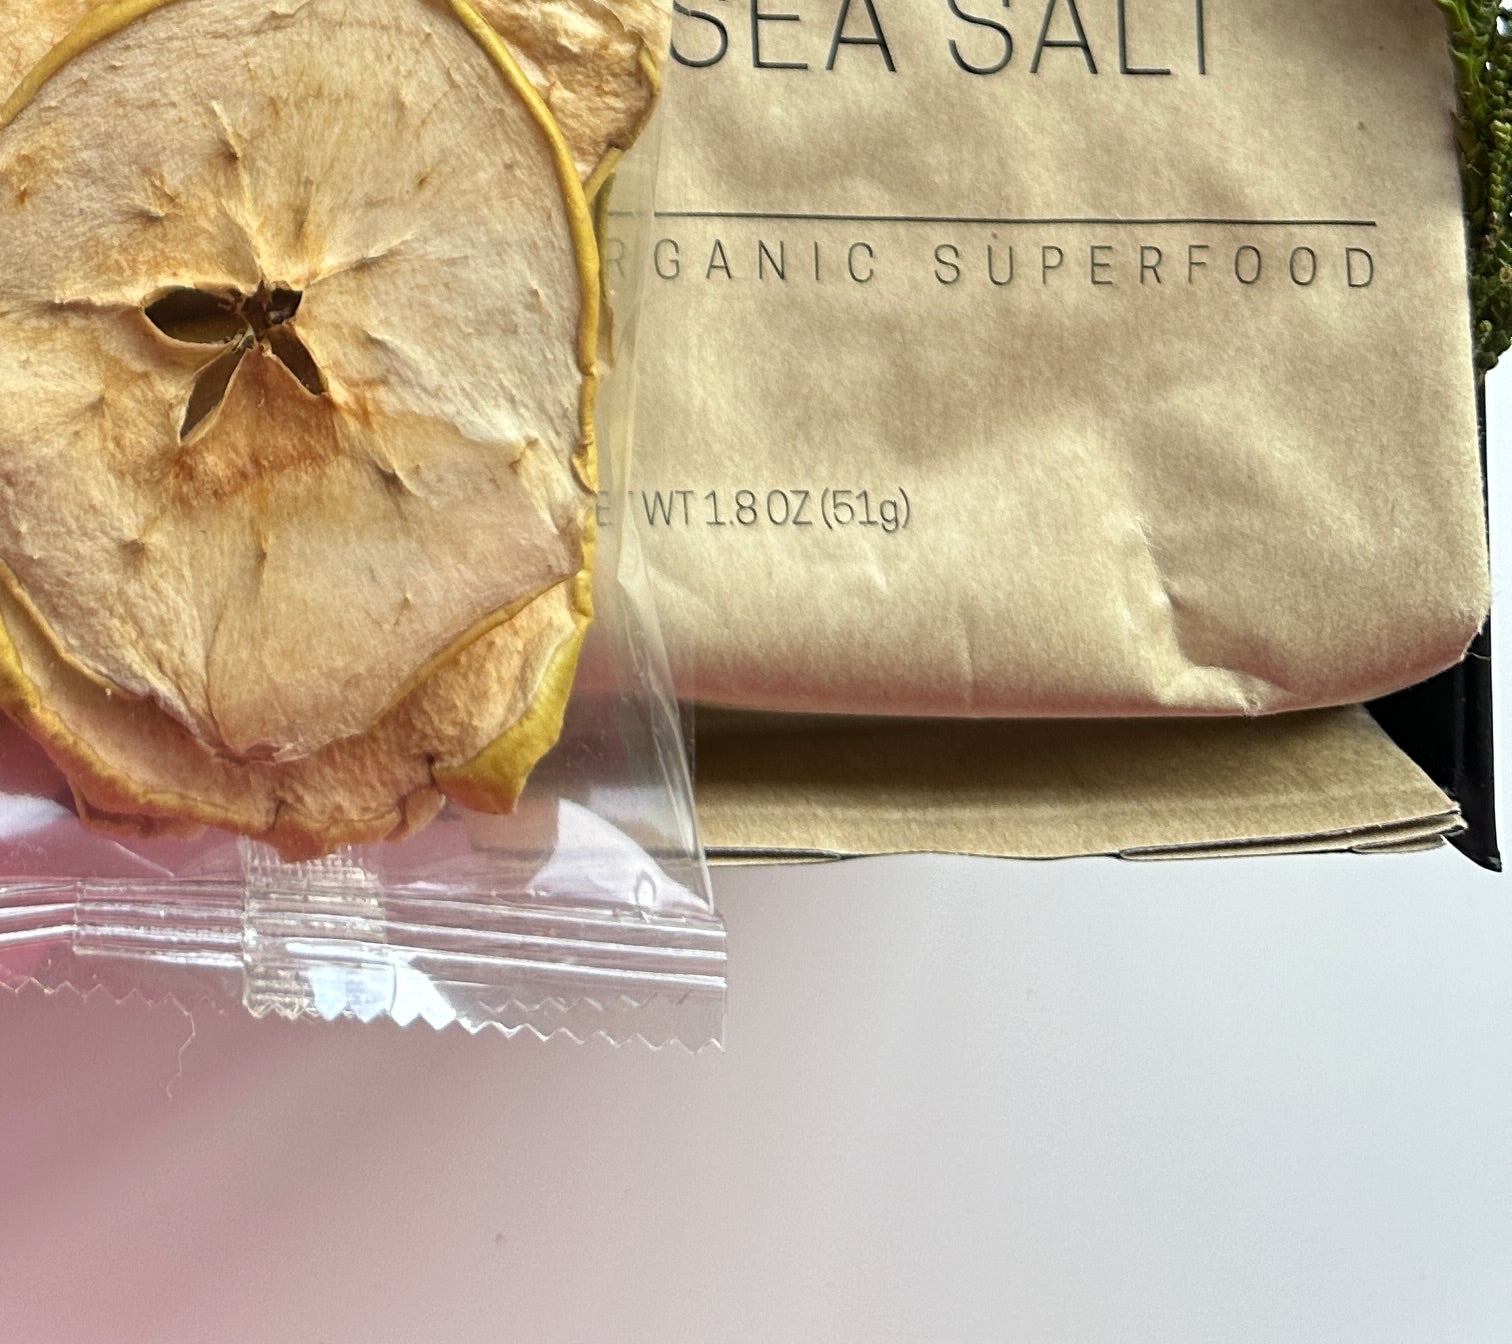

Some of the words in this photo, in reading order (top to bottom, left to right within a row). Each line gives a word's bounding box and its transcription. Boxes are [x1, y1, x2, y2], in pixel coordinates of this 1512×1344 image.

[603, 235, 879, 285] RGANIC
[933, 241, 1377, 291] SUPERFOOD
[642, 489, 694, 528] WT
[706, 489, 758, 528] 1.8
[767, 489, 814, 528] OZ
[821, 486, 911, 534] (51g)
